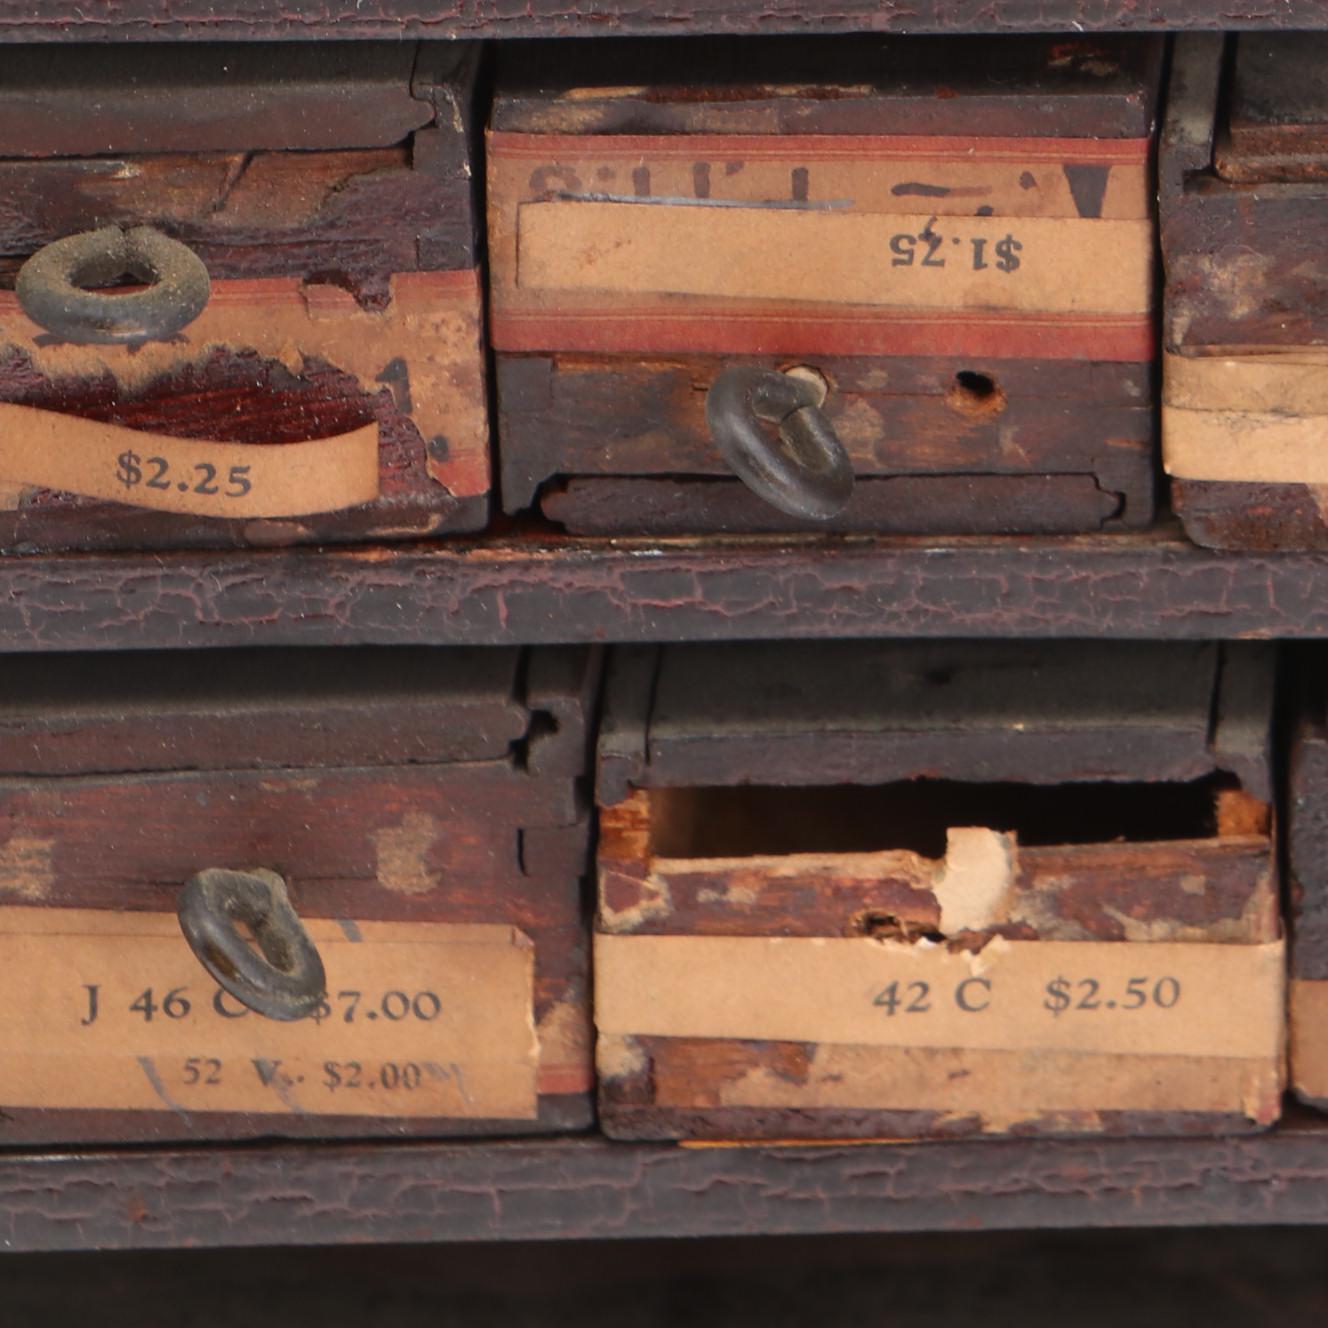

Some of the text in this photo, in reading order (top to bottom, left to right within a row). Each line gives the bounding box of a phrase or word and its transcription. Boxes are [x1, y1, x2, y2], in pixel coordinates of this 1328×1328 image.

[116, 449, 252, 498] $2.25
[80, 984, 99, 1027] J
[129, 986, 192, 1022] 46
[872, 975, 1181, 1018] 42 C $2.50
[183, 1058, 222, 1086] 52
[320, 1058, 426, 1094] $2.00
